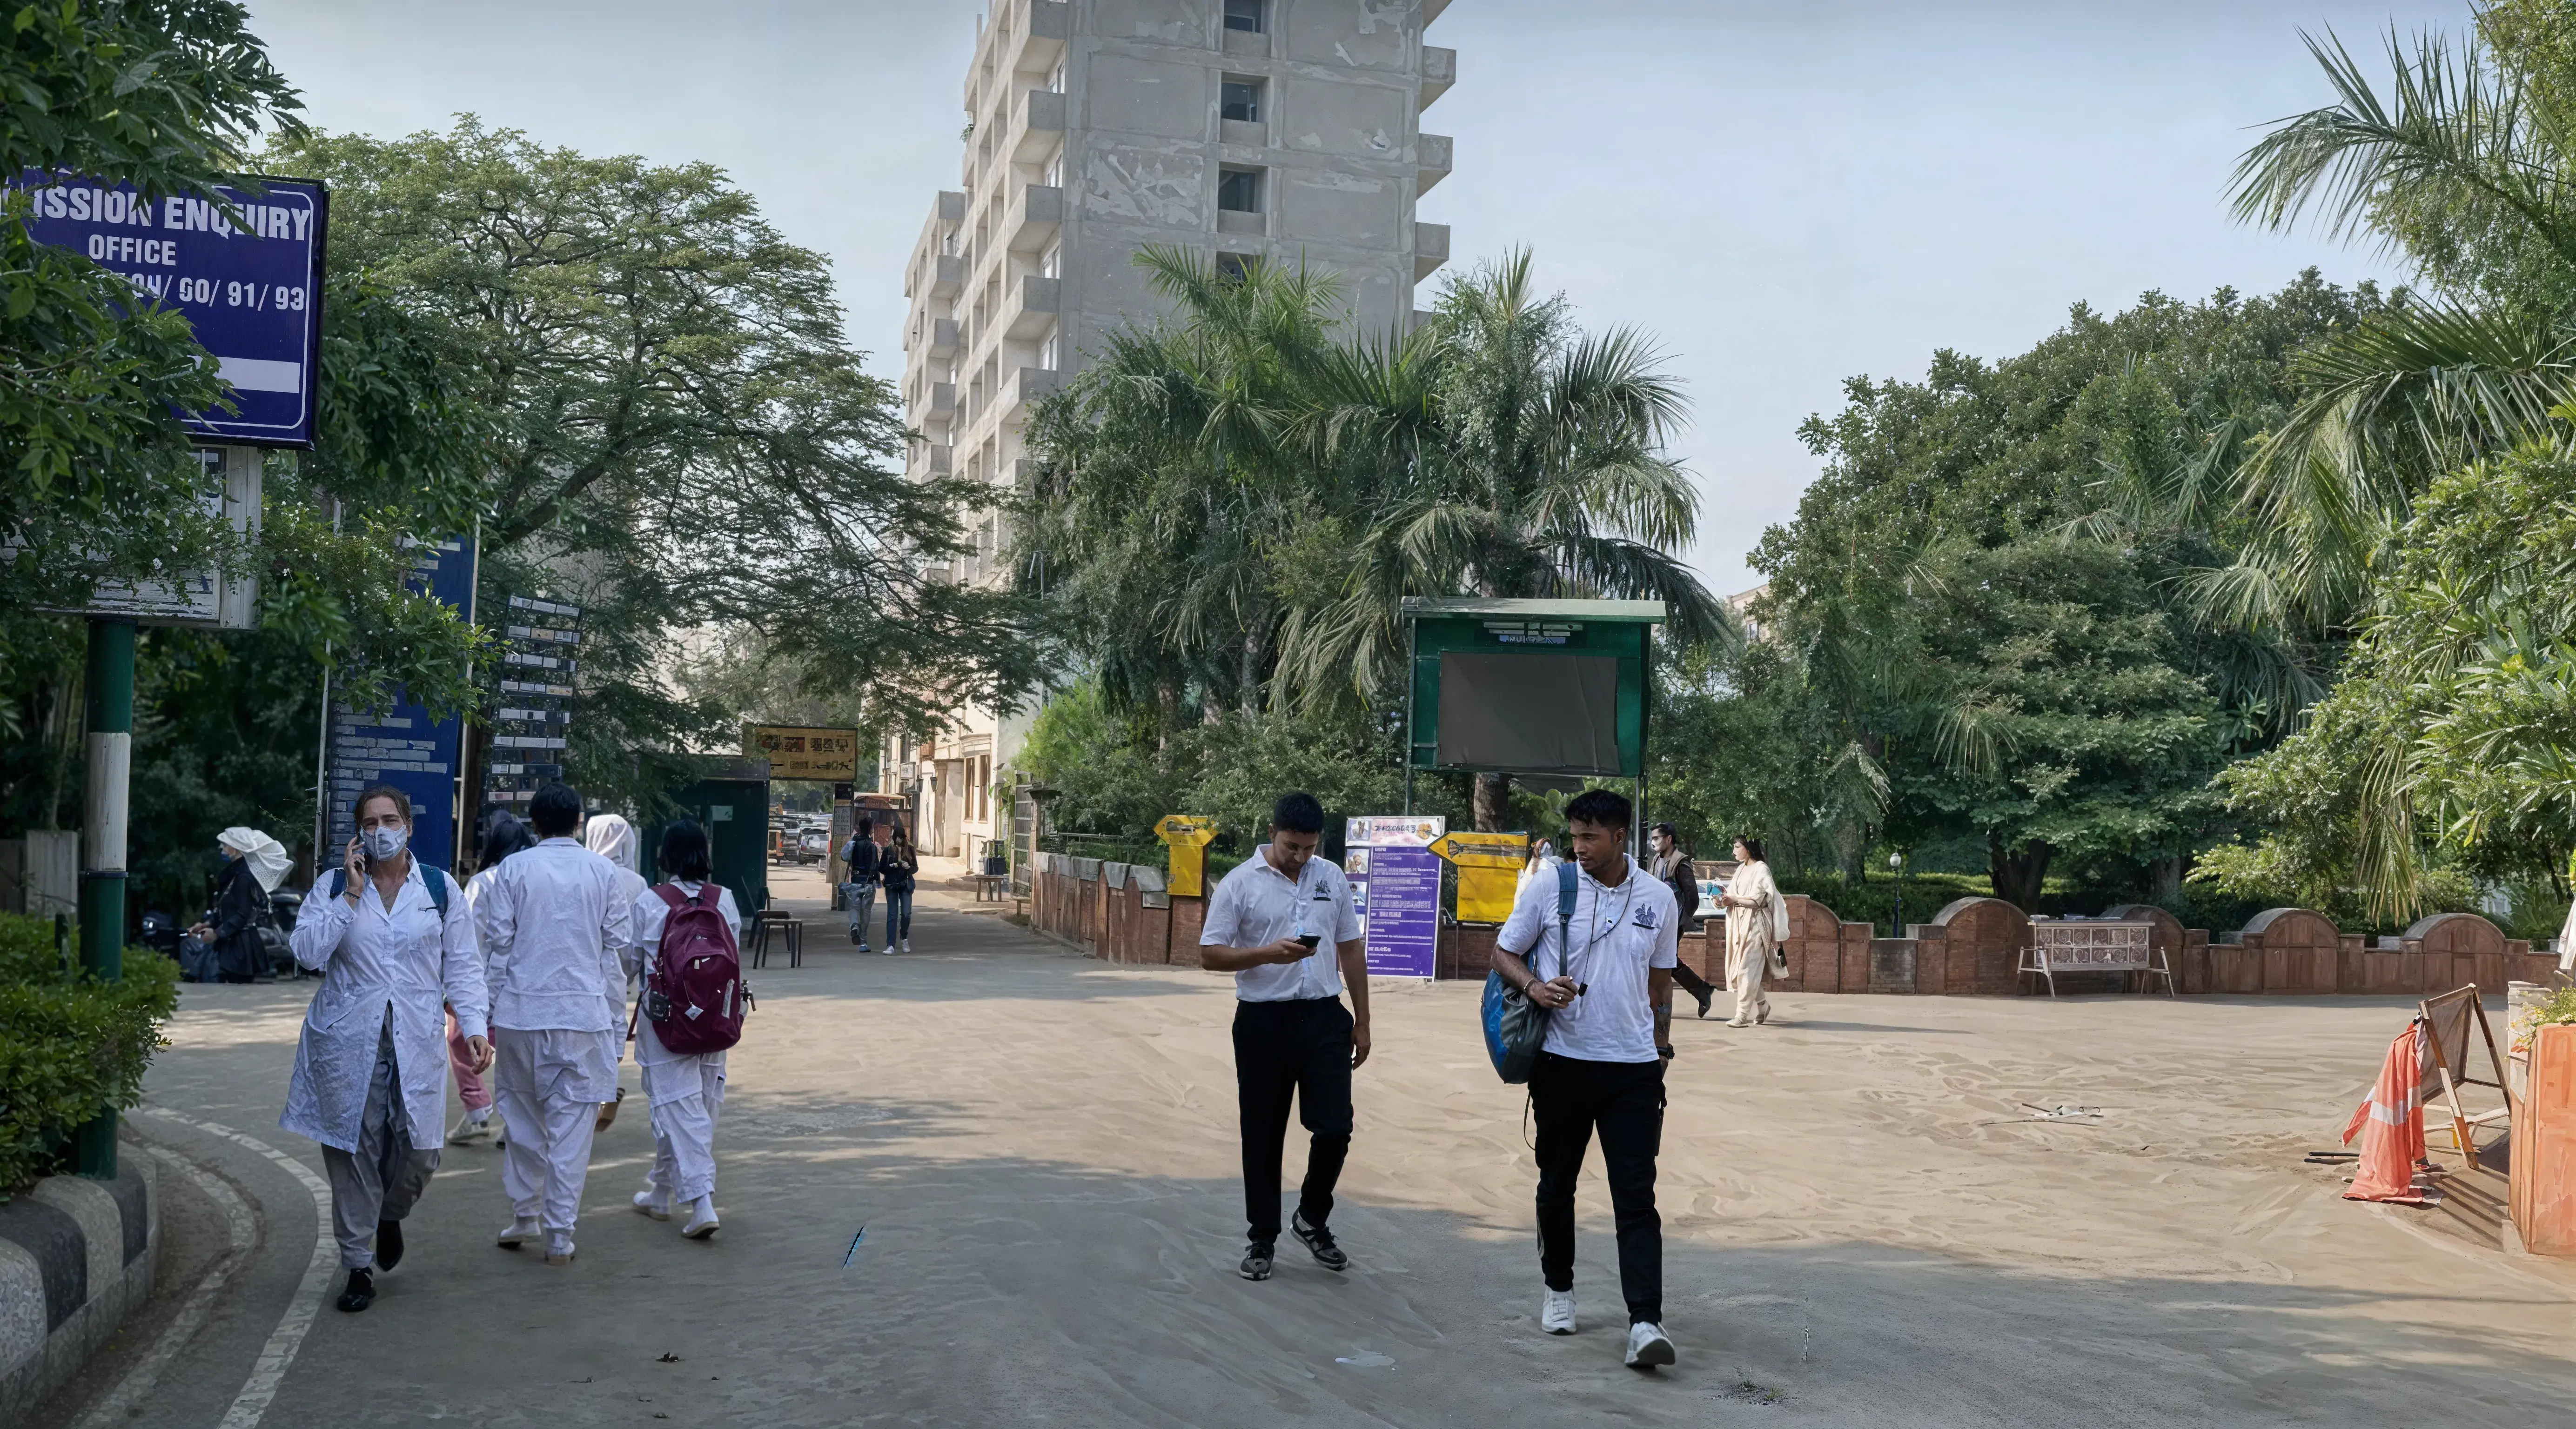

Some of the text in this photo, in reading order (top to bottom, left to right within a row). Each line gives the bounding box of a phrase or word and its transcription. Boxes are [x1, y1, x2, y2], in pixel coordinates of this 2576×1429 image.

[2, 176, 311, 241] ISSION ENQUIRY
[89, 234, 176, 266] OFFICE
[228, 281, 269, 311] 91/
[275, 286, 304, 311] 93
